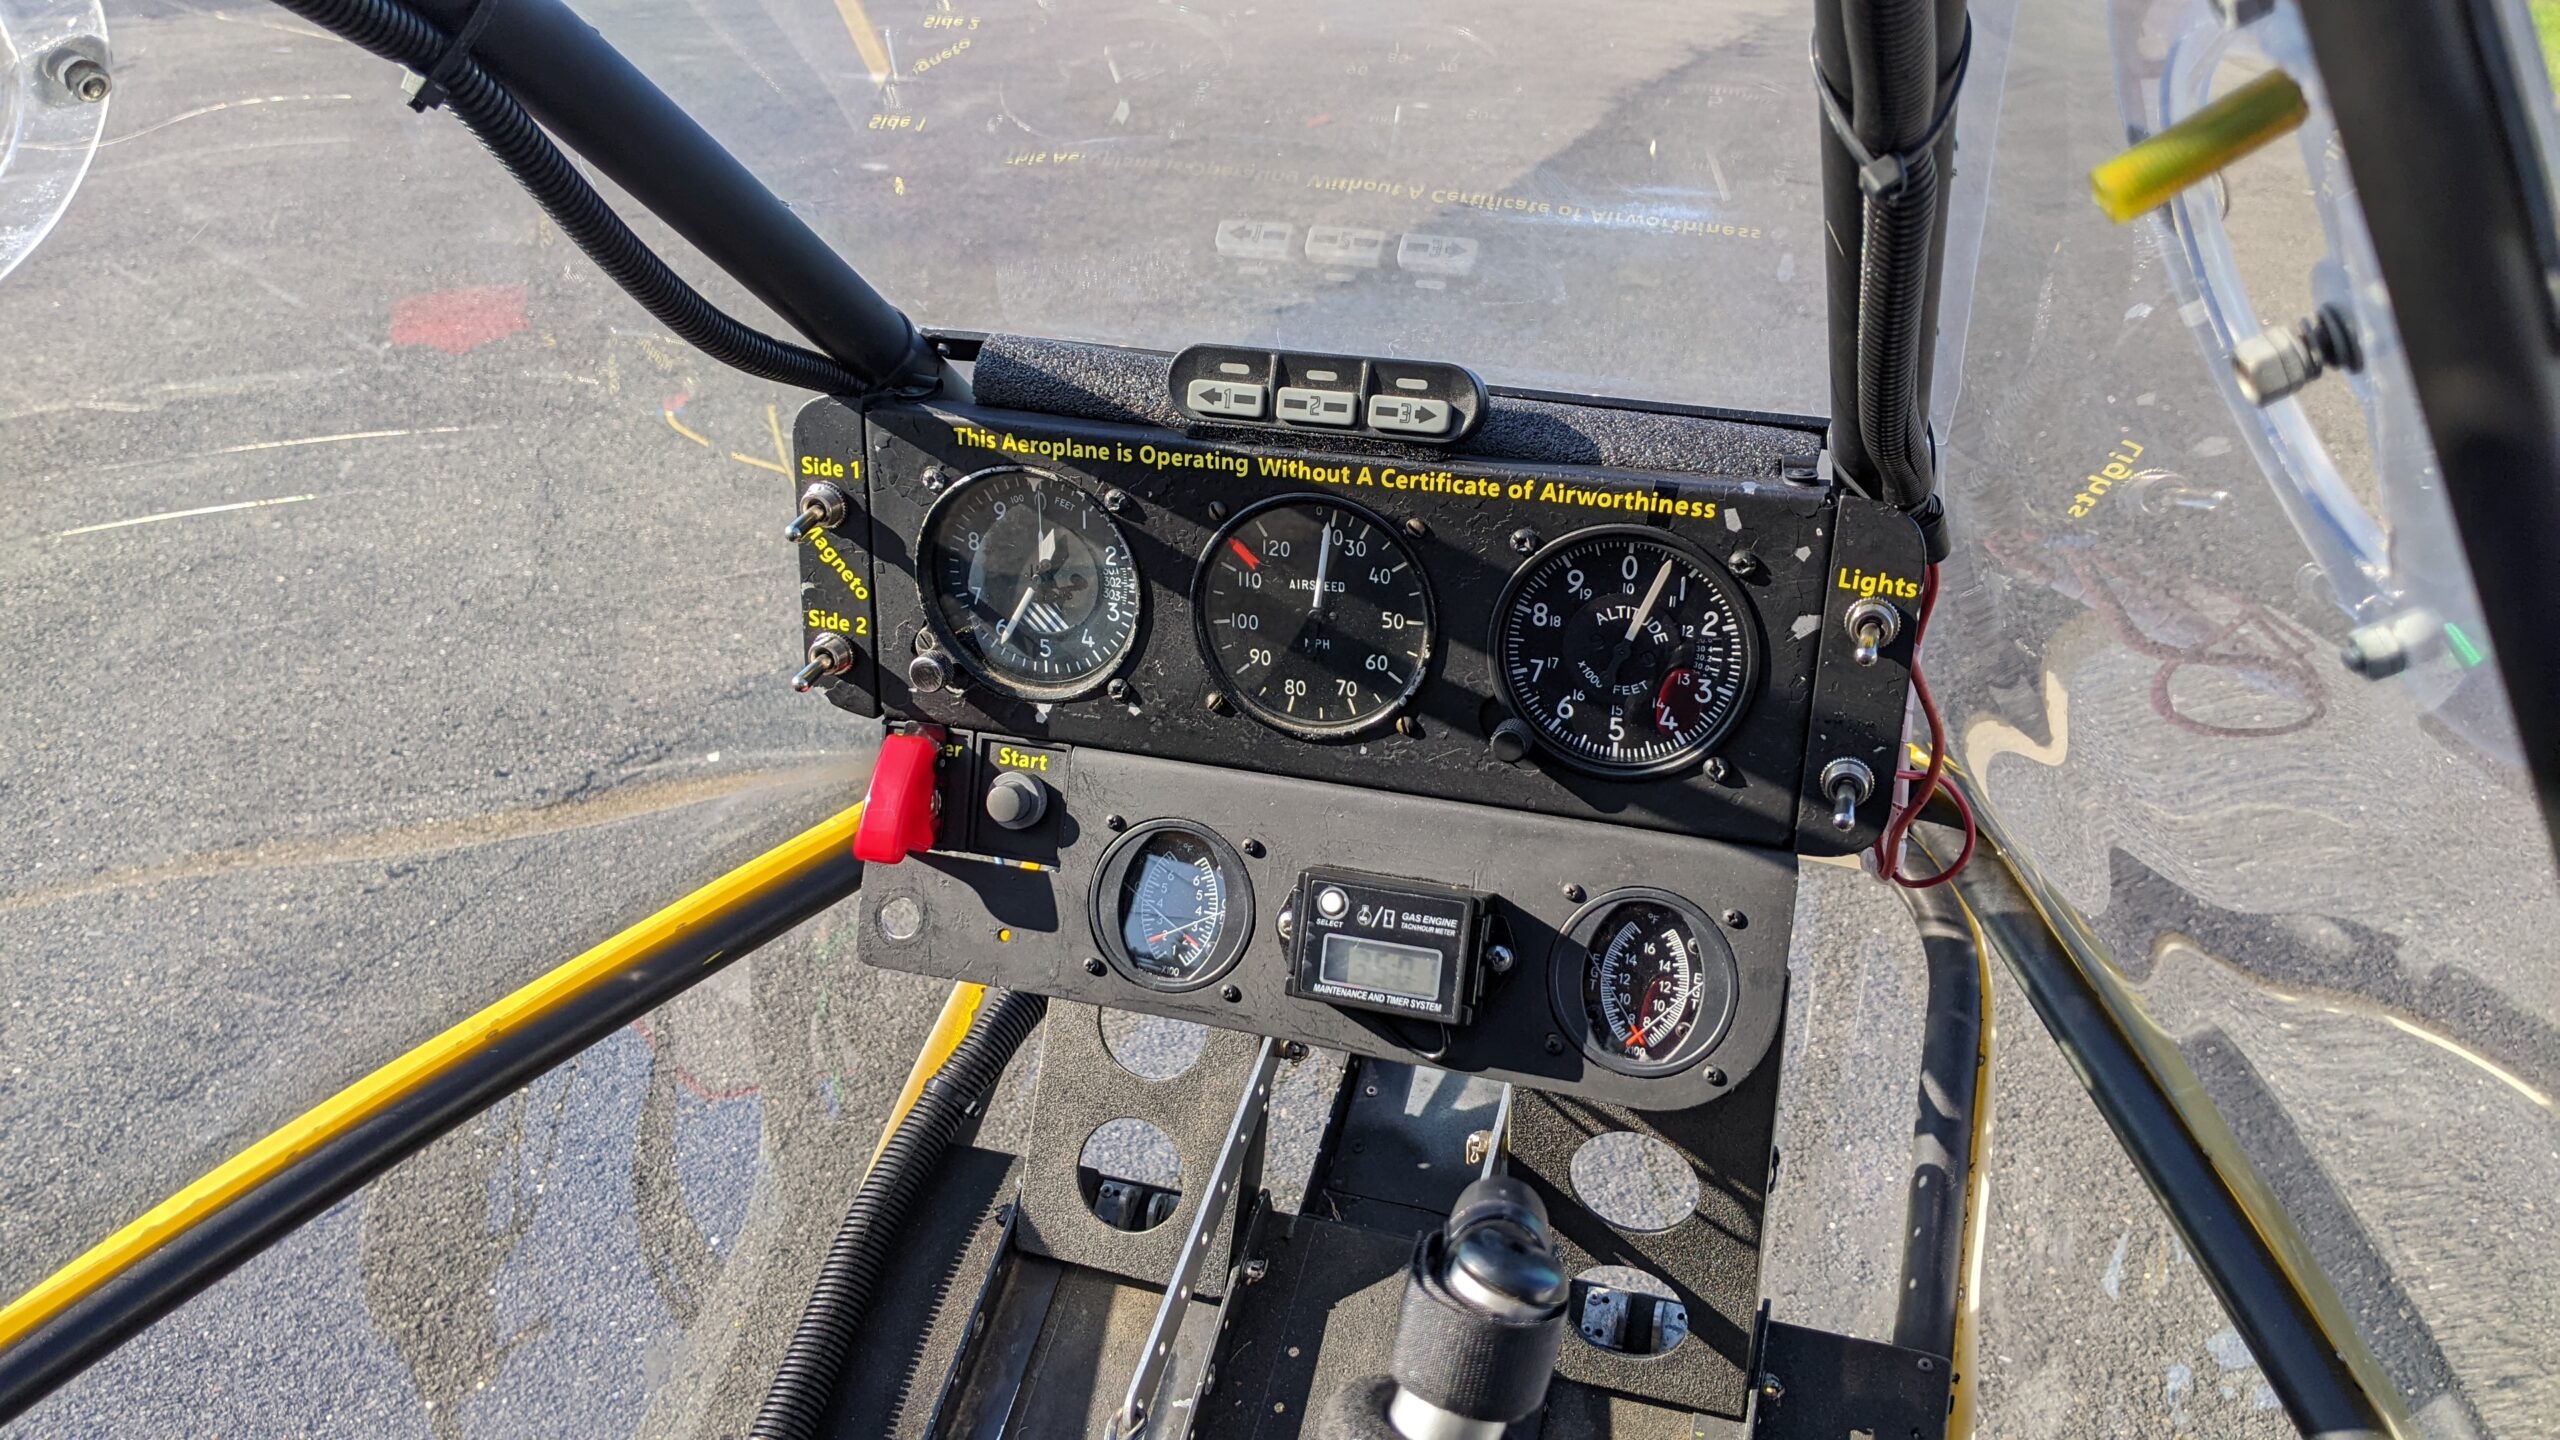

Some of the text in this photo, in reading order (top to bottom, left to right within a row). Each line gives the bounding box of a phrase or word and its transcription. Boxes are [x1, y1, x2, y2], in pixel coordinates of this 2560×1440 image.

[1224, 388, 1231, 409] 1
[1310, 396, 1320, 416] 2
[1400, 403, 1412, 424] 3
[801, 456, 860, 480] Side 1
[953, 427, 1716, 518] This Aeroplane is Operating Without A Certificate of Airworthiness
[994, 502, 1006, 521] 9
[1055, 496, 1077, 512] FEET
[968, 532, 980, 550] 8
[1262, 540, 1290, 558] 120
[1344, 540, 1366, 558] 30
[1106, 546, 1117, 566] 2
[1368, 568, 1390, 584] 40
[1622, 556, 1638, 580] 0
[1238, 572, 1262, 588] 110
[1289, 579, 1346, 592] AIRSEED
[1567, 570, 1584, 594] 9
[1838, 568, 1918, 599] Lights
[971, 586, 982, 604] 7
[1580, 588, 1593, 600] 19
[1622, 584, 1635, 594] 10
[1107, 602, 1120, 622] 3
[1532, 602, 1548, 627] 8
[808, 609, 867, 635] Side 2
[996, 619, 1008, 637] 6
[1231, 612, 1260, 630] 100
[1382, 612, 1404, 630] 50
[1550, 615, 1562, 628] 18
[1701, 610, 1719, 637] 2
[1082, 628, 1096, 648] 4
[1681, 624, 1694, 638] 12
[1040, 638, 1052, 658] 5
[1250, 648, 1272, 666] 90
[1365, 654, 1388, 672] 60
[1546, 657, 1560, 669] 17
[1530, 659, 1544, 682] 7
[1284, 680, 1306, 696] 80
[1336, 679, 1358, 696] 70
[1612, 680, 1648, 696] FEET
[1677, 673, 1690, 686] 13
[1573, 689, 1585, 701] 16
[1694, 678, 1712, 704] 3
[1557, 696, 1574, 719] 6
[1611, 704, 1624, 716] 15
[1652, 698, 1666, 710] 14
[1660, 706, 1678, 731] 4
[1608, 716, 1625, 741] 5
[999, 747, 1048, 772] Start
[1168, 870, 1174, 881] 6
[1193, 875, 1200, 886] 6
[1161, 882, 1168, 894] 5
[1196, 890, 1203, 901] 5
[1156, 898, 1163, 908] 4
[1195, 905, 1202, 916] 4
[1316, 918, 1344, 928] SELECT
[1402, 912, 1458, 928] GAS ENGINE
[1434, 928, 1456, 936] METER
[1172, 944, 1176, 956] 1
[1644, 942, 1656, 955] 16
[1625, 954, 1638, 966] 14
[1659, 960, 1671, 972] 14
[1619, 974, 1631, 986] 12
[1659, 981, 1671, 994] 12
[1313, 984, 1442, 1012] MAINTENANCE AND TIMER SYSTEM
[1619, 993, 1631, 1005] 10
[1653, 1000, 1666, 1012] 10
